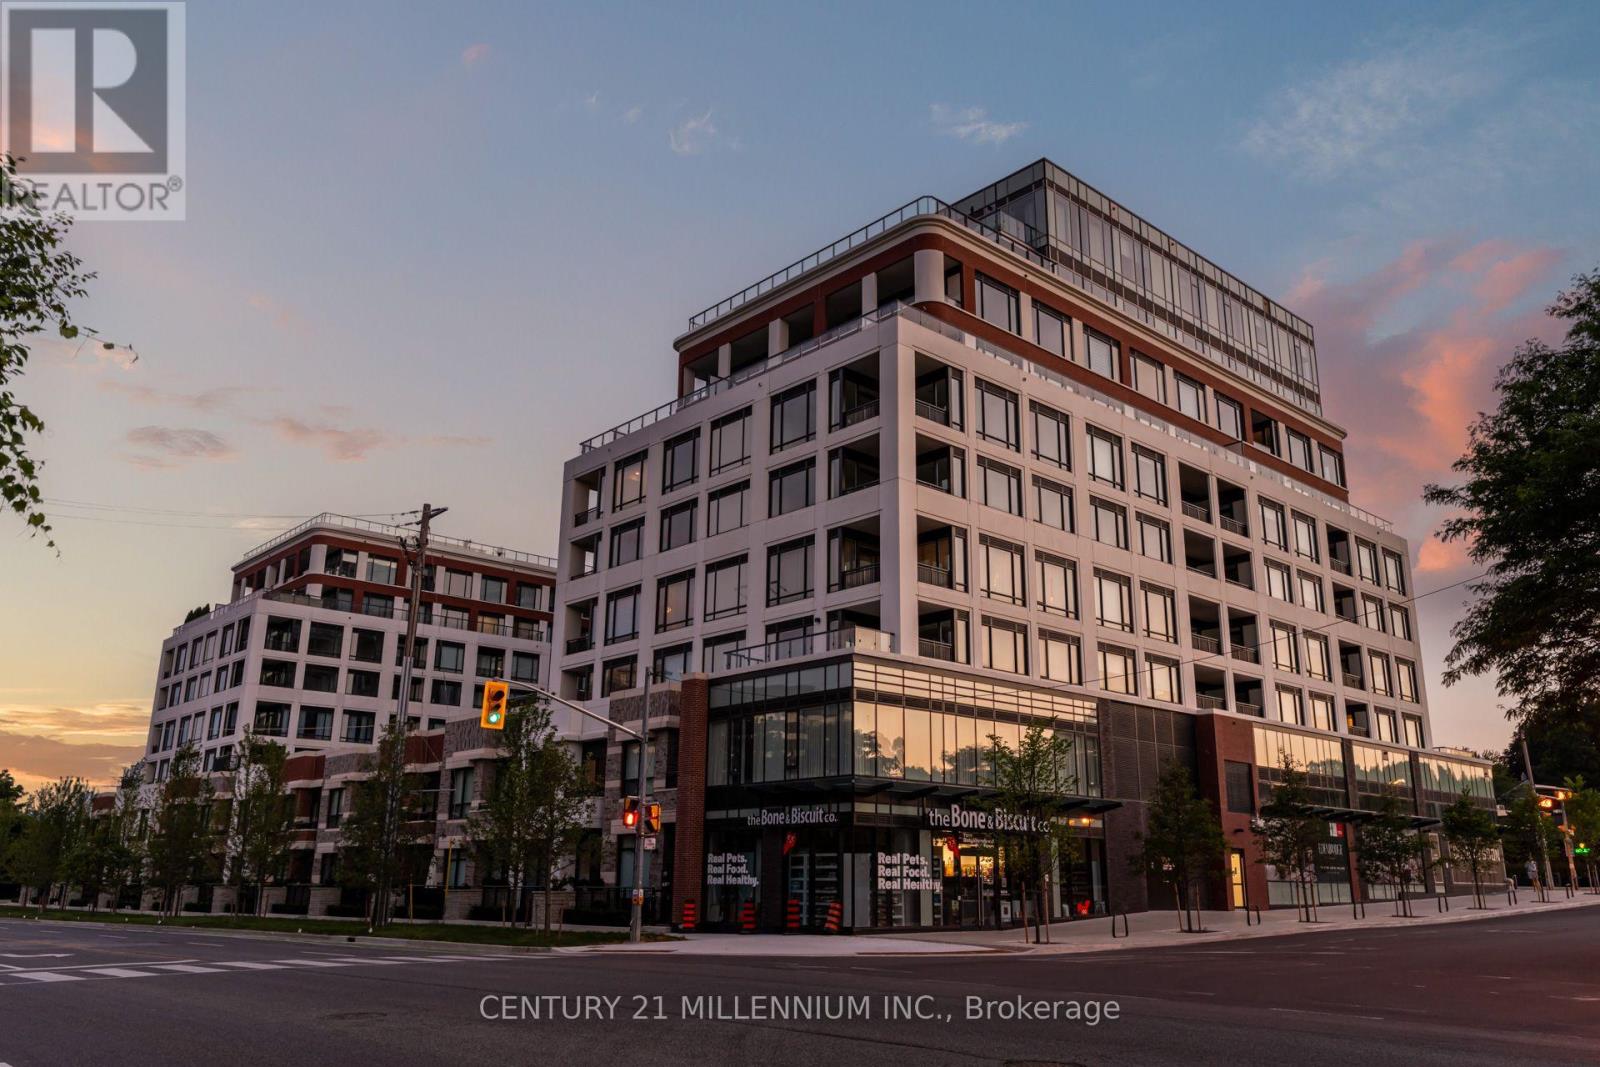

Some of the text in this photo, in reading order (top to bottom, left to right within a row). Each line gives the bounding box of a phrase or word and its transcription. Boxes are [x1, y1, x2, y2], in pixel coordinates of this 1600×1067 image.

[747, 815, 760, 826] the
[761, 809, 785, 826] Bone
[791, 806, 824, 825] Biscuit
[929, 809, 951, 827] the
[951, 804, 987, 829] Bone
[987, 816, 994, 829] &
[707, 853, 748, 864] Real Pets.
[877, 852, 928, 866] Real Pets.
[707, 864, 749, 874] Real Food.
[877, 865, 931, 878] Real Food.
[707, 874, 759, 887] Real Healthy.
[877, 878, 943, 893] Real Healthy.
